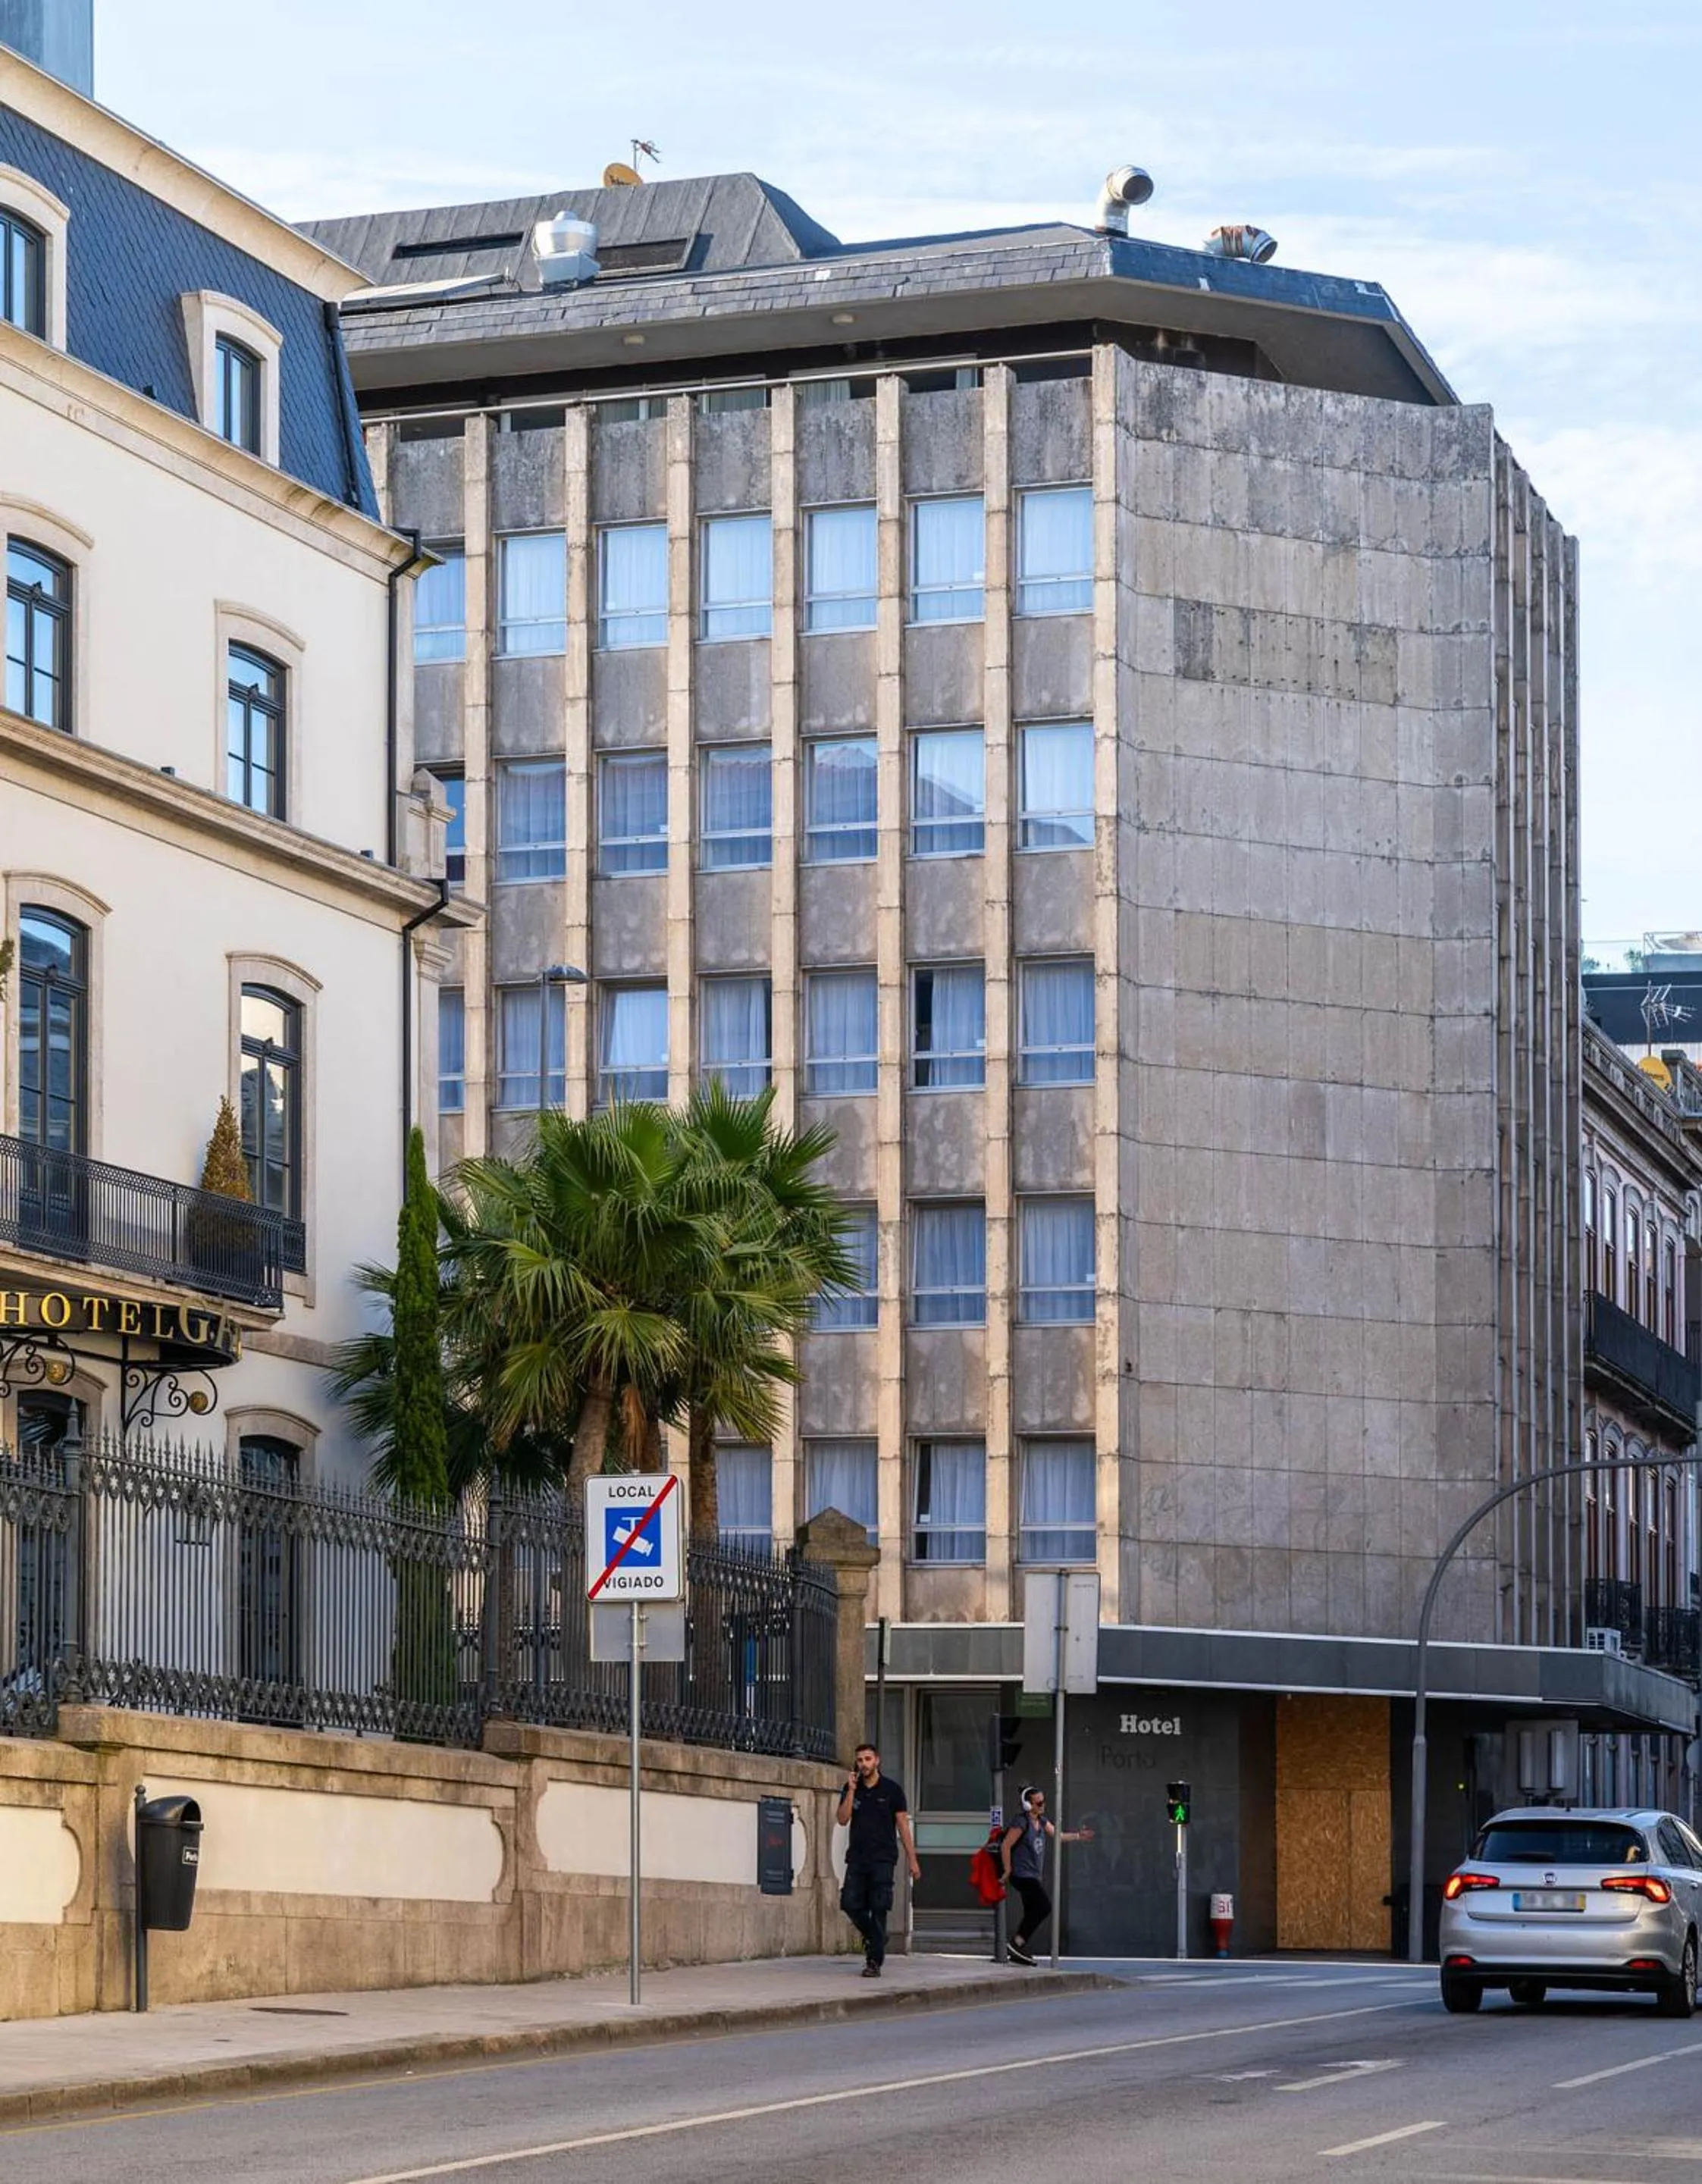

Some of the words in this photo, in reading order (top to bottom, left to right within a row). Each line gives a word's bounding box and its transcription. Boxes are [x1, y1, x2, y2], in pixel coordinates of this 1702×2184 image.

[0, 1292, 174, 1340] HOTEL
[609, 1486, 656, 1498] LOCAL
[603, 1576, 664, 1589] VIGIADO
[1120, 1714, 1183, 1734] Hotel
